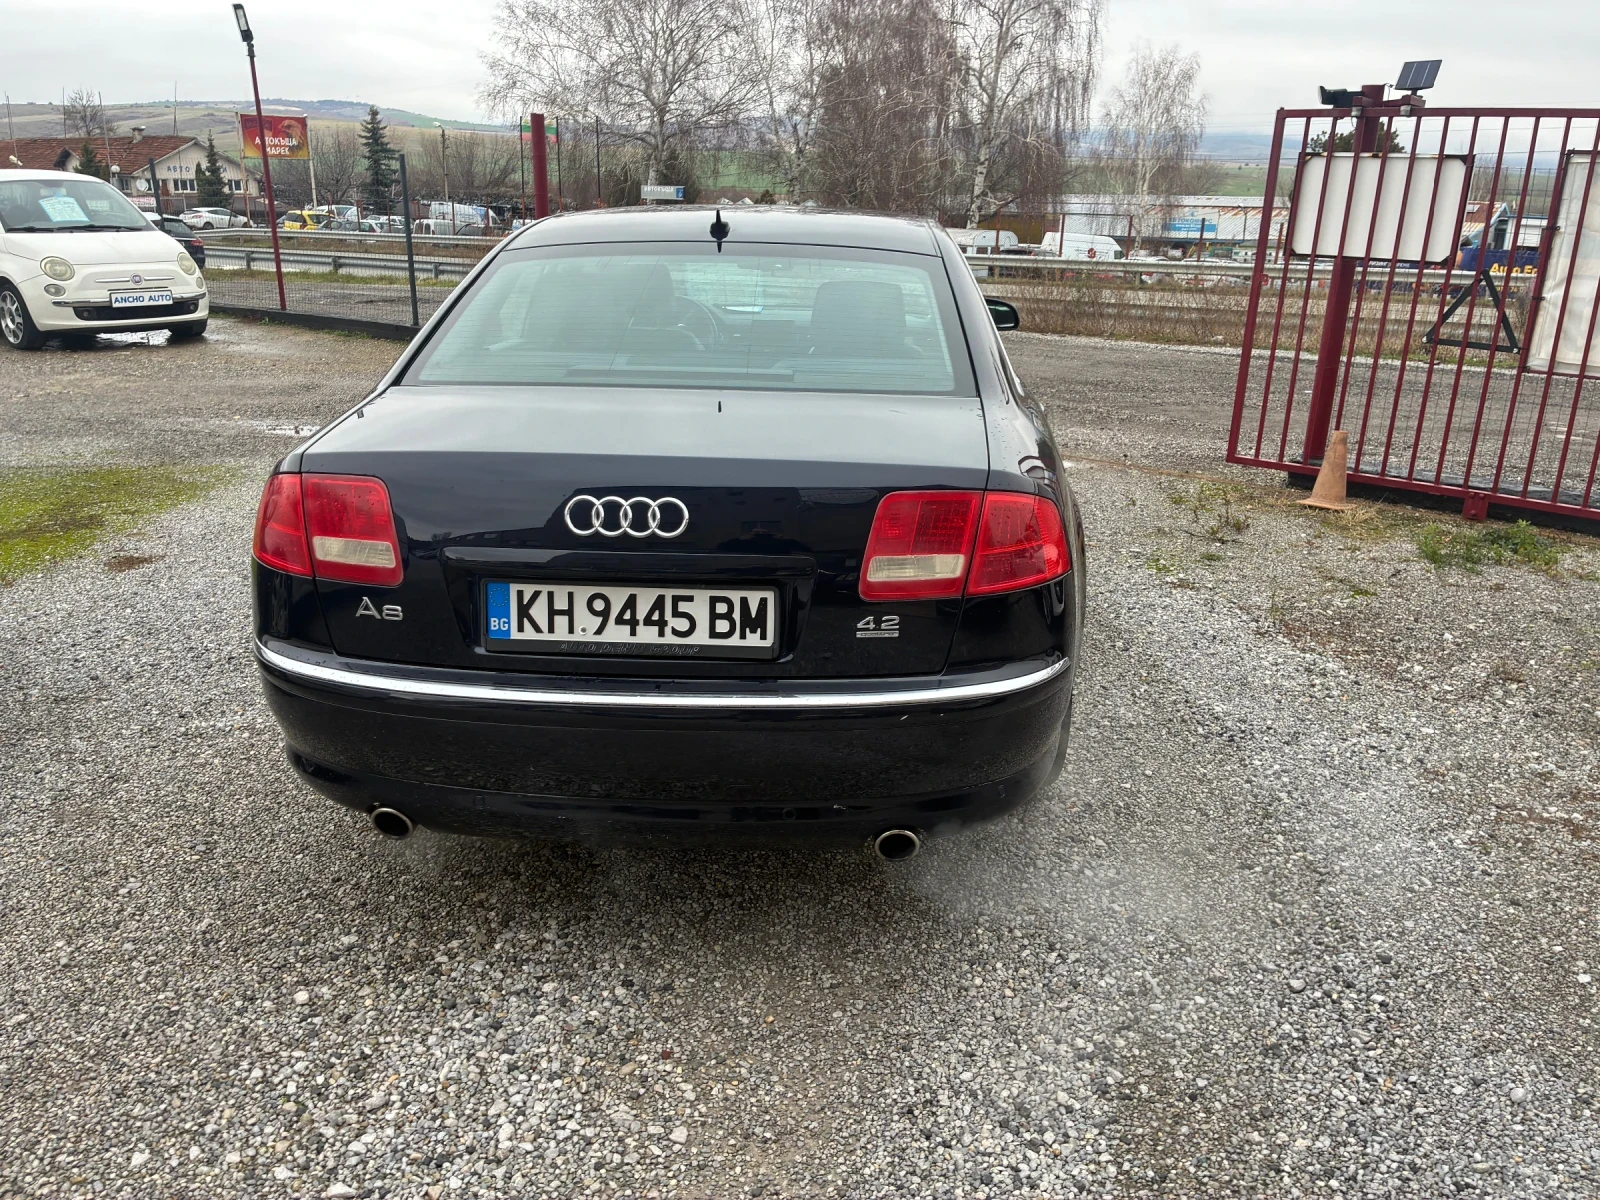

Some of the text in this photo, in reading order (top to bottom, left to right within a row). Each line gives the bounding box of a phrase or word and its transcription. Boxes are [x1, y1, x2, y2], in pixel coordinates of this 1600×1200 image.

[255, 136, 297, 146] АТОКЪЩА
[1489, 263, 1521, 273] Auo
[114, 294, 171, 304] ANCHO AUTO
[355, 596, 403, 620] A8
[586, 592, 697, 638] 9445
[708, 595, 768, 641] BM
[490, 617, 509, 631] BG
